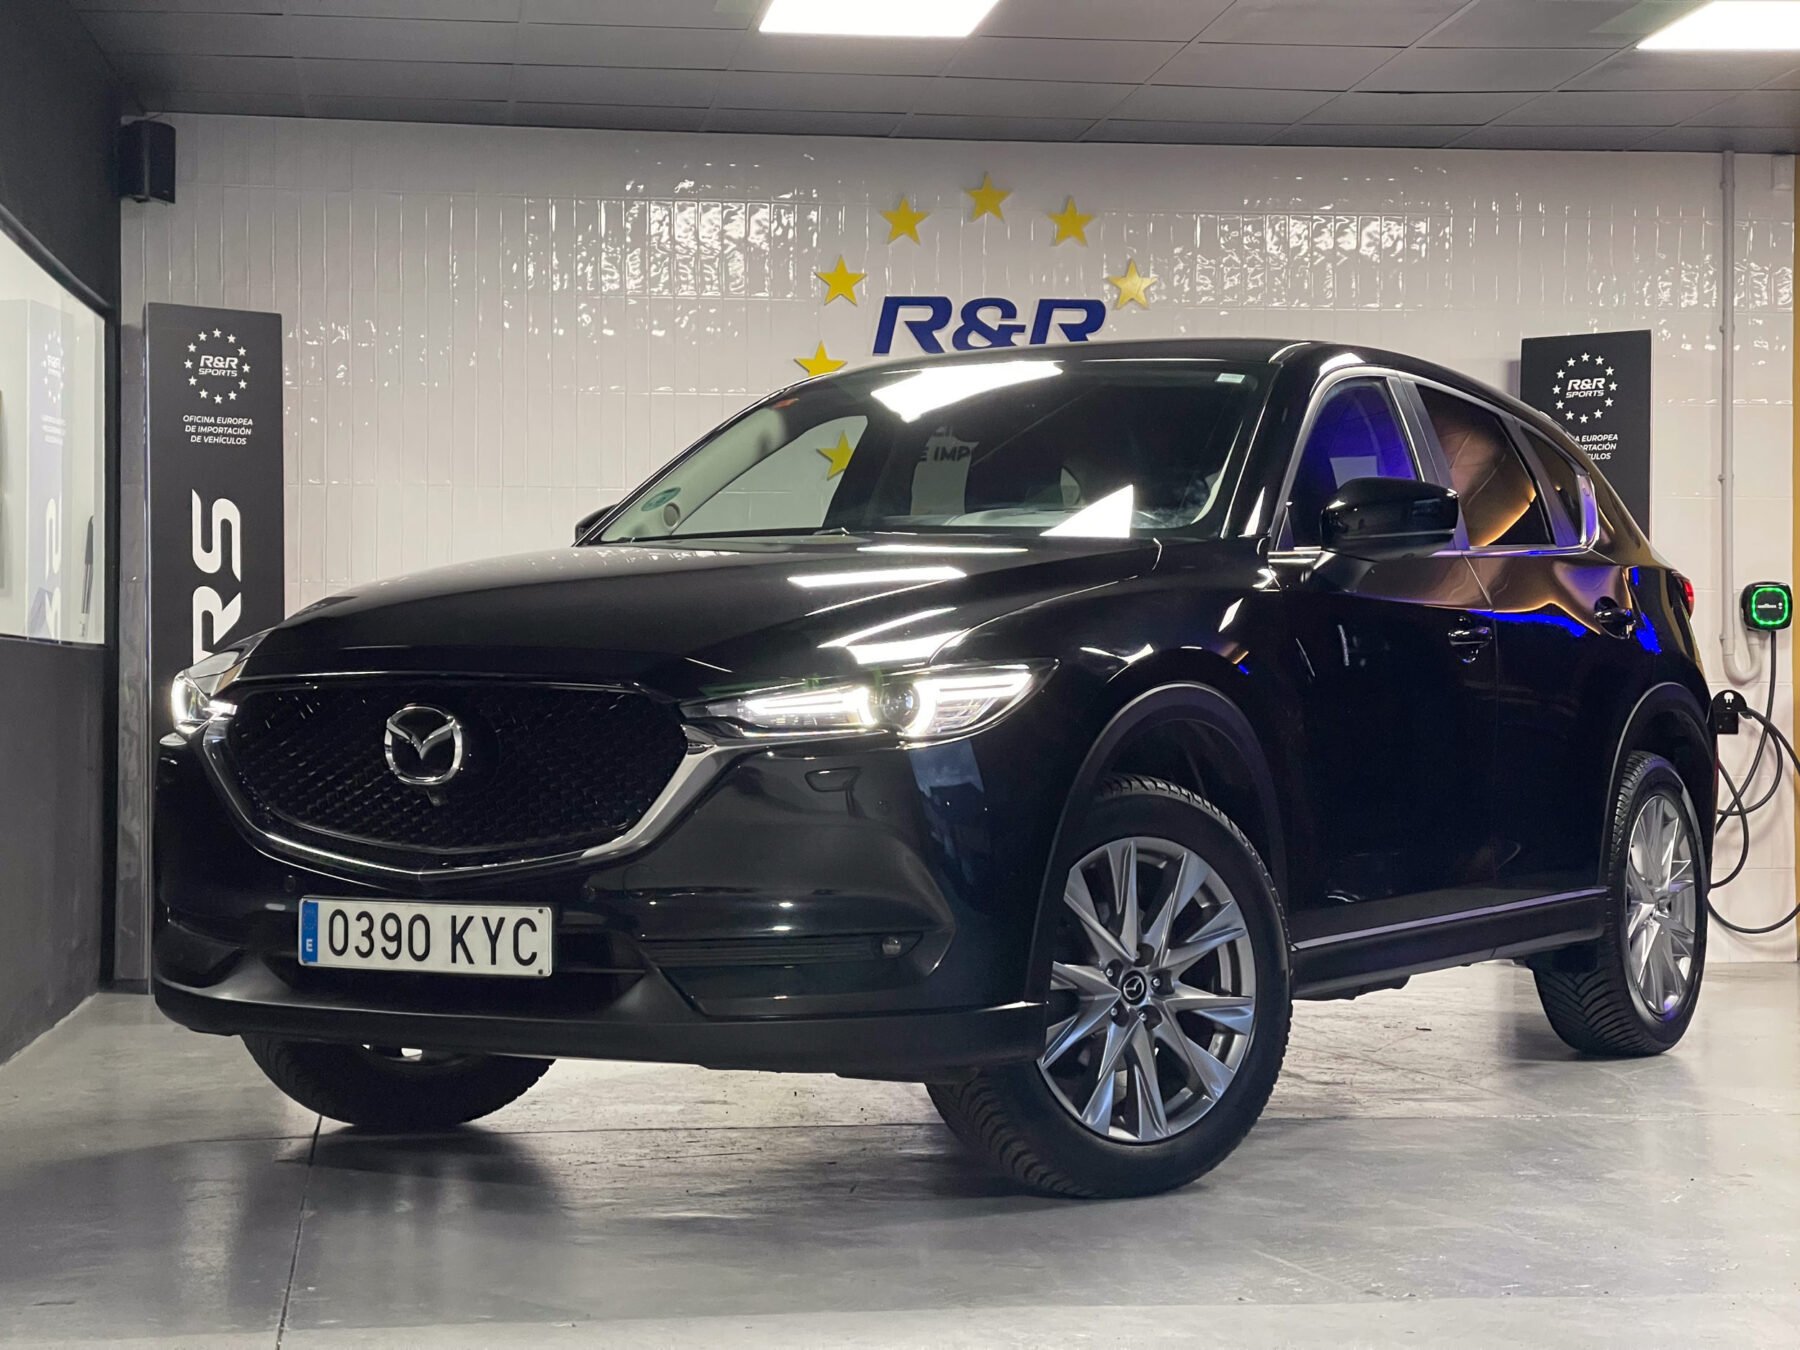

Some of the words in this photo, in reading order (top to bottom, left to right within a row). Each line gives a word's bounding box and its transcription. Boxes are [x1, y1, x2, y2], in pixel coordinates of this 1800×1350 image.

[872, 296, 1106, 354] R&R
[200, 355, 238, 369] R&R
[198, 368, 238, 377] SPORTS
[1567, 378, 1605, 391] R&R
[1565, 390, 1604, 398] SPORTS
[183, 415, 215, 424] OFICINA
[216, 416, 253, 426] EUROPEA
[185, 424, 196, 433] DE
[197, 425, 252, 435] IMPORTACIÓN
[190, 434, 201, 443] DE
[203, 434, 247, 445] VEHÍCULOS
[1581, 433, 1618, 442] EUROPEA
[305, 938, 313, 952] E
[328, 908, 430, 962] 0390
[450, 914, 538, 966] KYC
